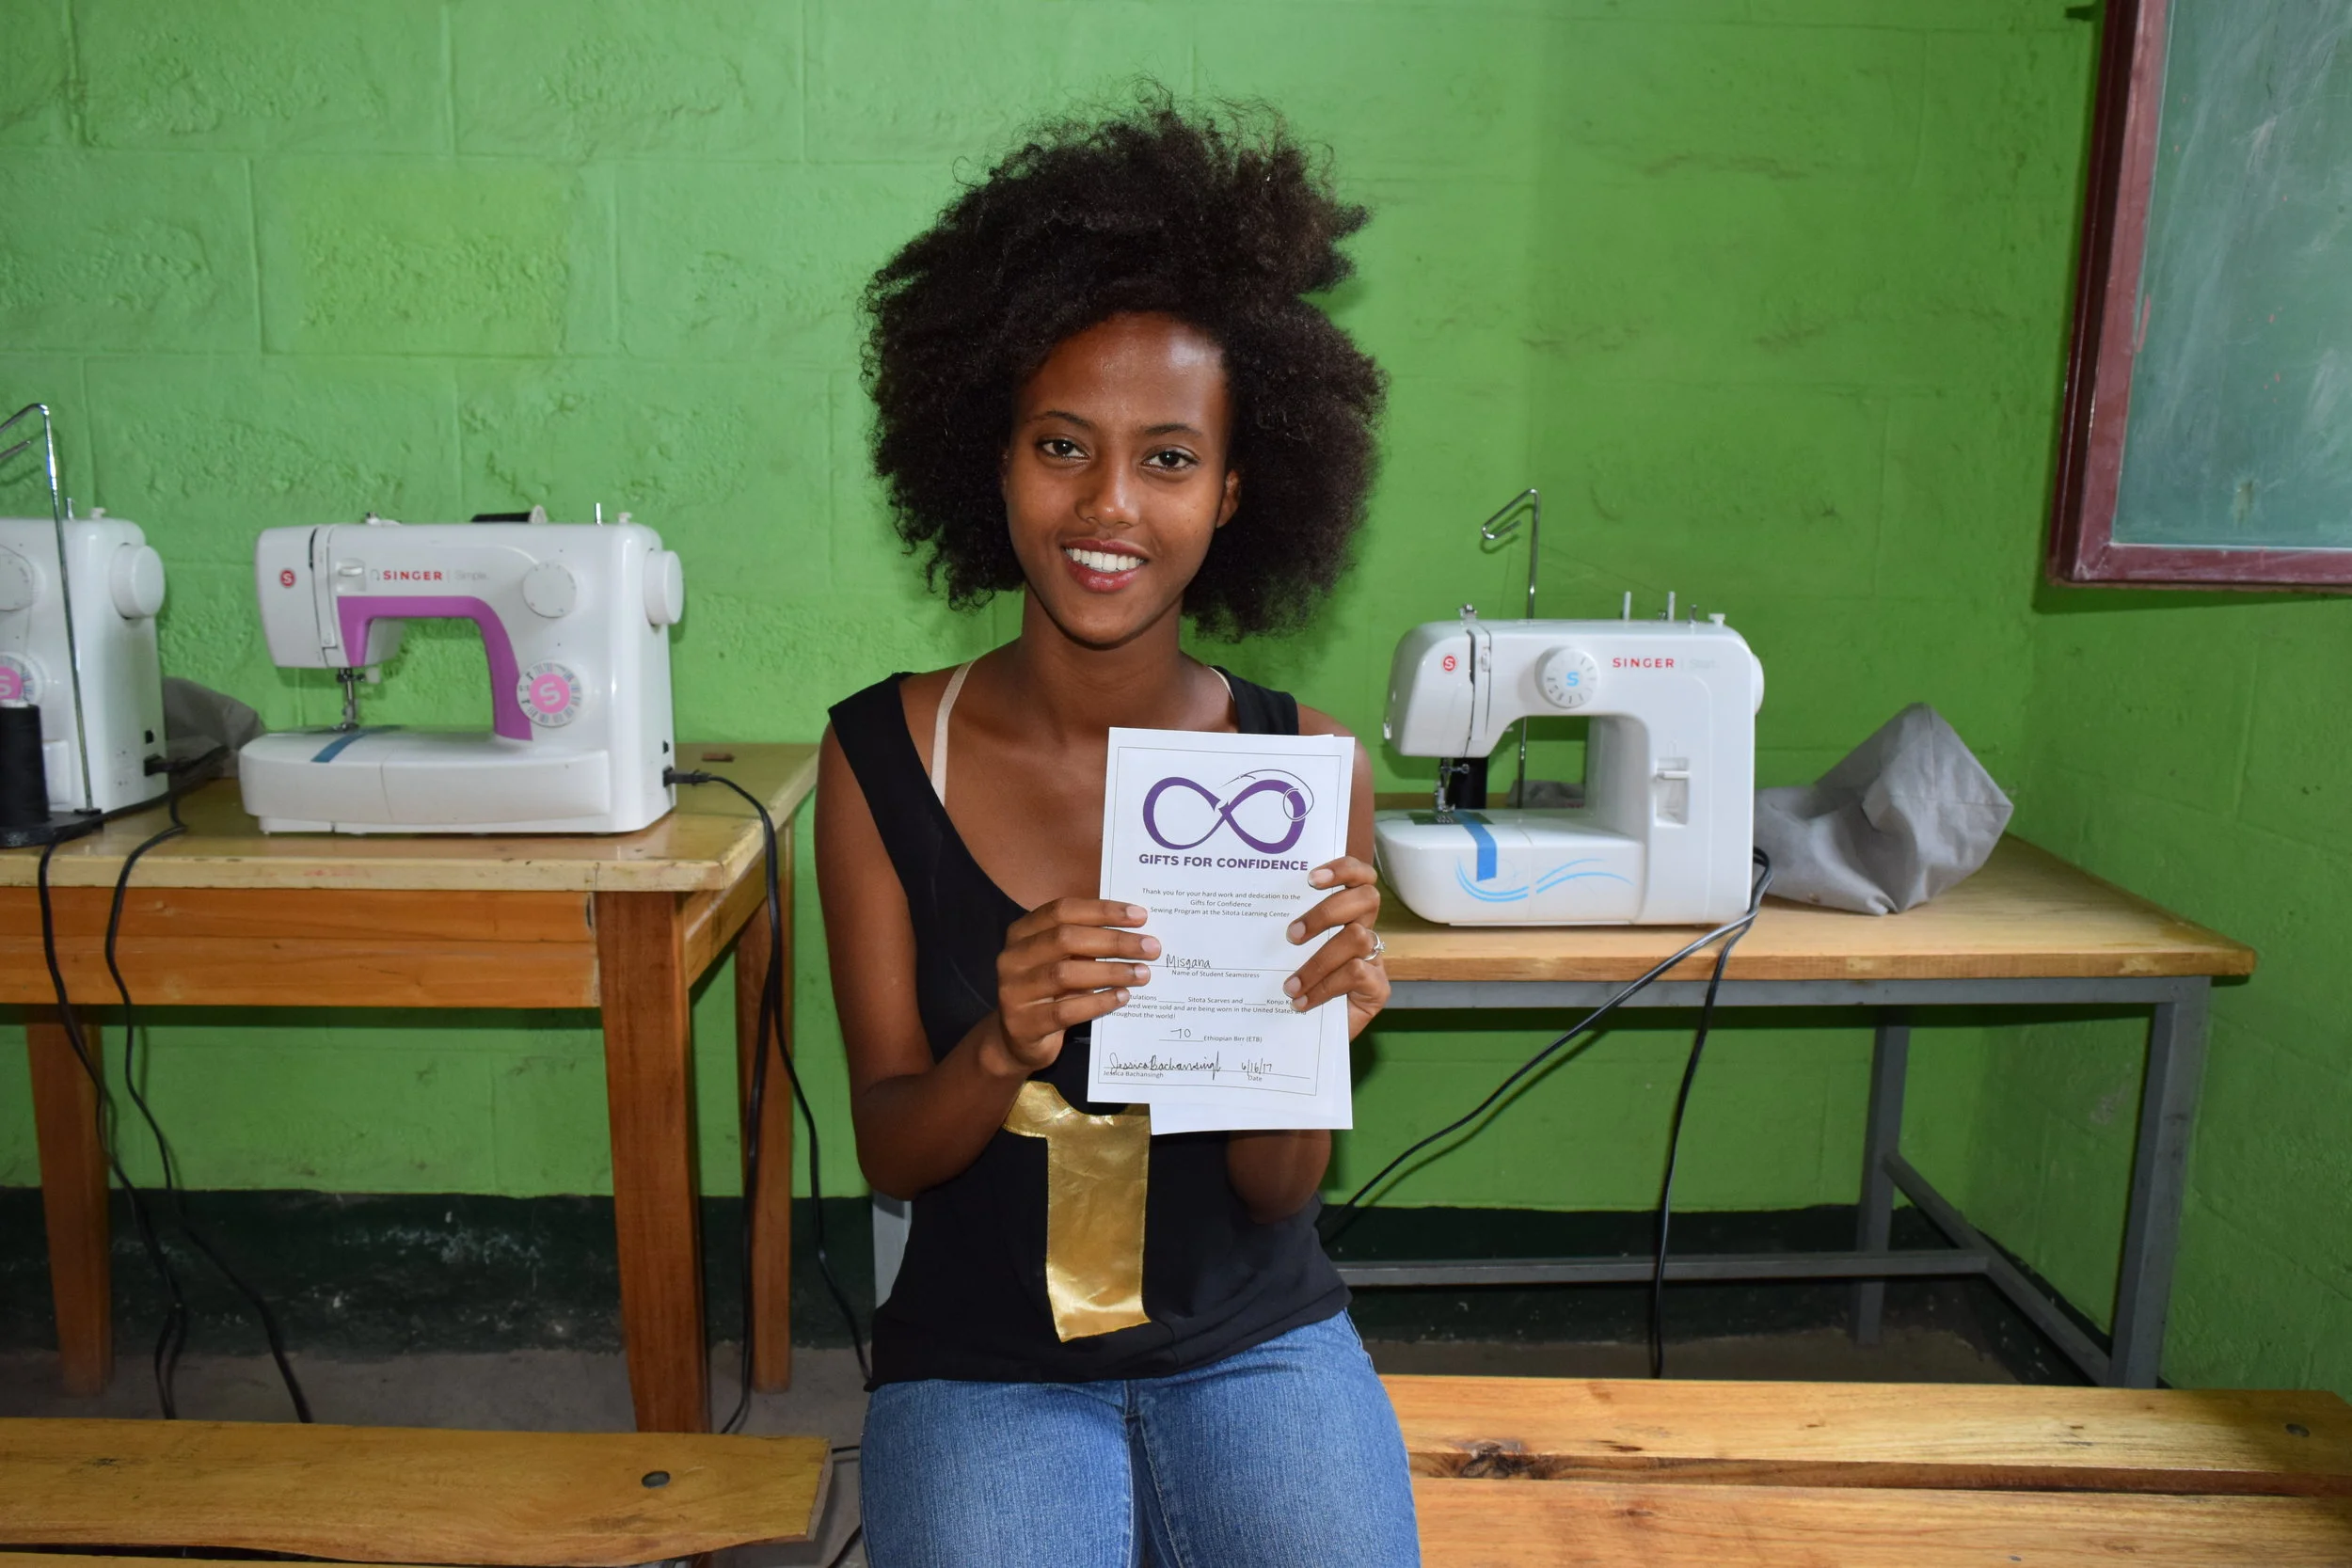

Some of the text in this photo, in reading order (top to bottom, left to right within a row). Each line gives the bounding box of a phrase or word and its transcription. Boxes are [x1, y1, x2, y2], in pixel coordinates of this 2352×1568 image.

[383, 570, 443, 581] SINGER
[1613, 657, 1675, 668] SINGER
[1565, 672, 1580, 687] S
[538, 681, 561, 705] S
[1138, 853, 1309, 871] GIFTS FOR CONFIDENCE
[1166, 953, 1211, 970] Misgana
[1125, 1070, 1164, 1079] Bachansingh
